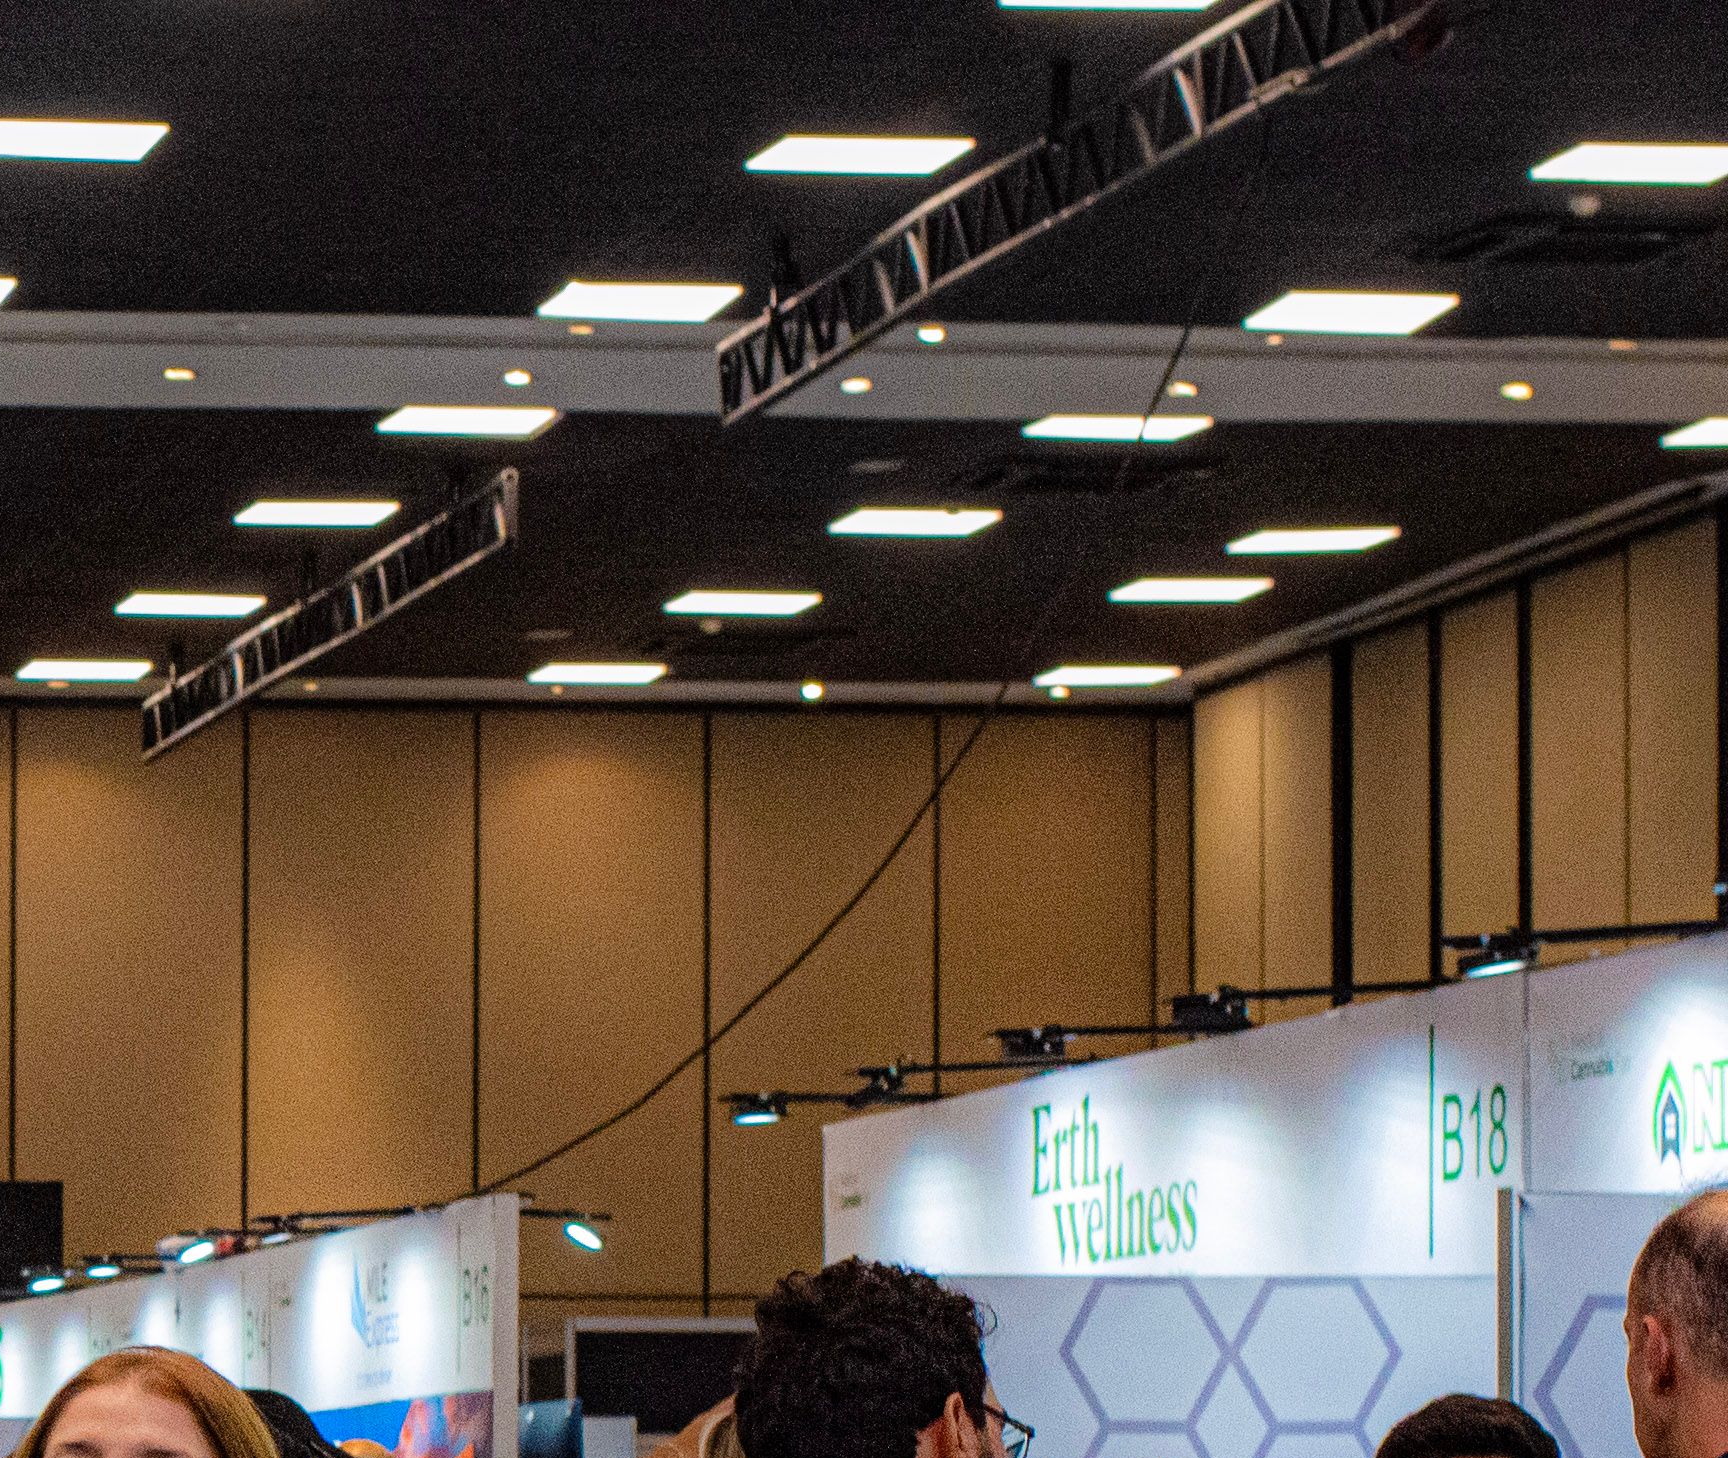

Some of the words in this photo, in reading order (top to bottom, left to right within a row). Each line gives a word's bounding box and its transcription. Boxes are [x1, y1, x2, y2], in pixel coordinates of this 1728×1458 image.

[1030, 1091, 1101, 1198] Erth
[1442, 1083, 1509, 1183] B18
[1052, 1162, 1198, 1266] wellness
